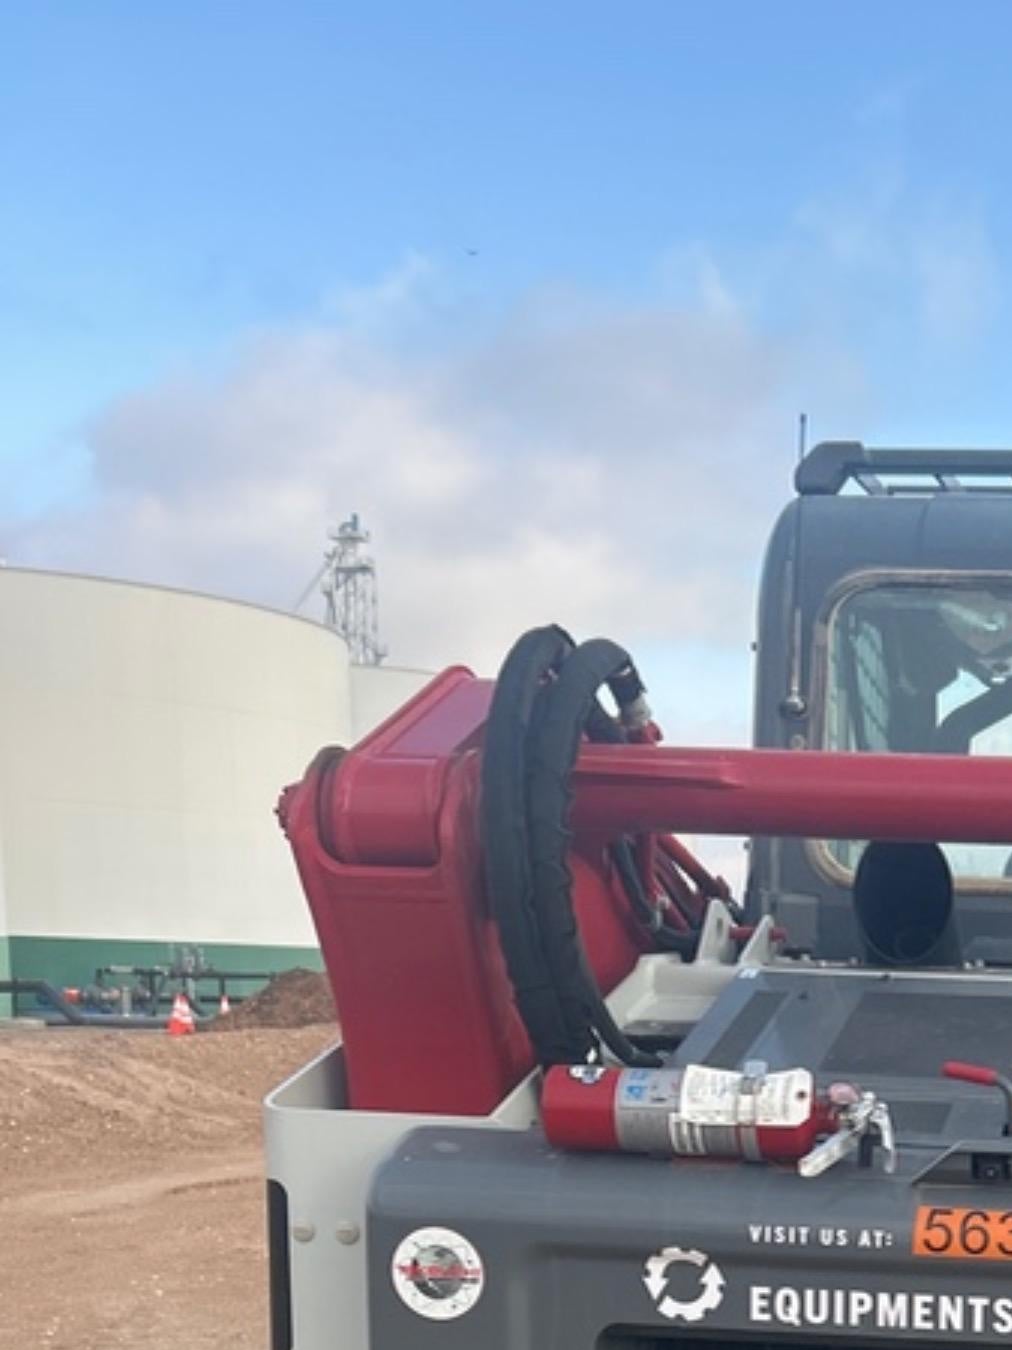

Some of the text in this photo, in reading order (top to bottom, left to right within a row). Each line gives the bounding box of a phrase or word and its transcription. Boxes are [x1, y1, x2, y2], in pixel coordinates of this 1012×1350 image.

[748, 1224, 893, 1248] VISIT US AT:
